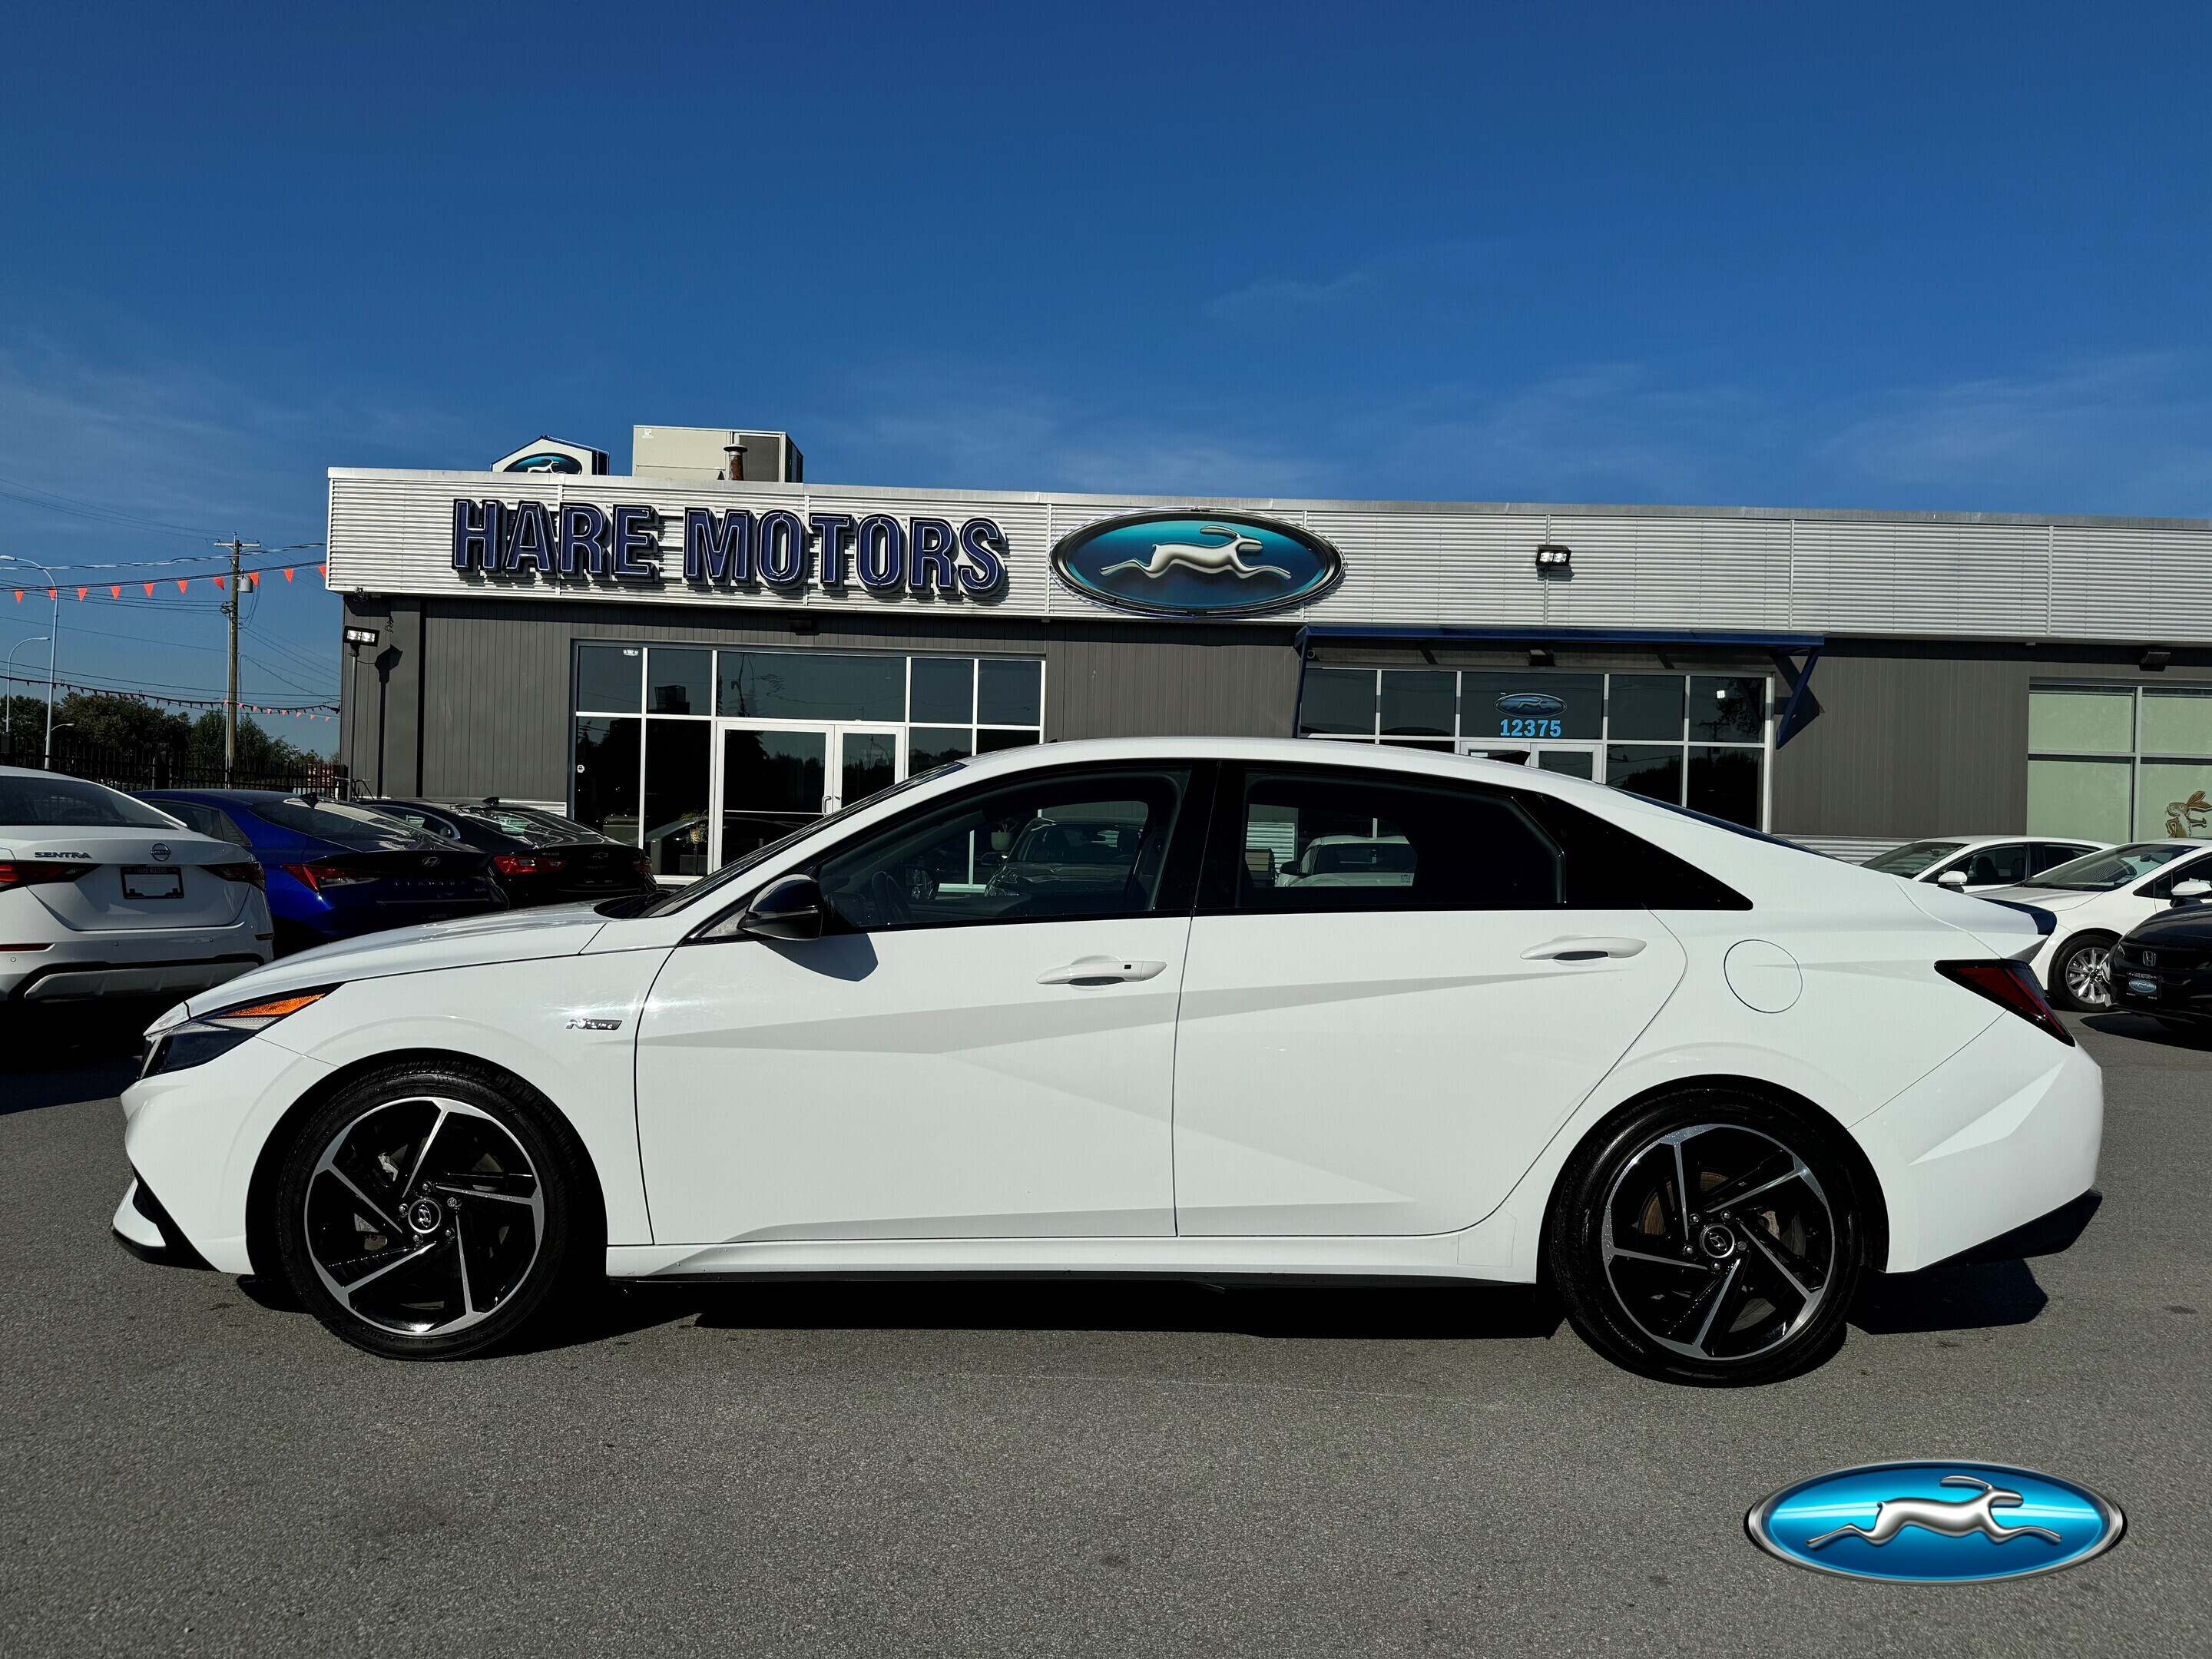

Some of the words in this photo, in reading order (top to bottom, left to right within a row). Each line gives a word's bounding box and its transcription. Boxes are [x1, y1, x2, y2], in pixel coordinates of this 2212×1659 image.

[452, 498, 657, 581] HARE
[684, 505, 1005, 595] MOTORS
[1500, 719, 1561, 737] 12375
